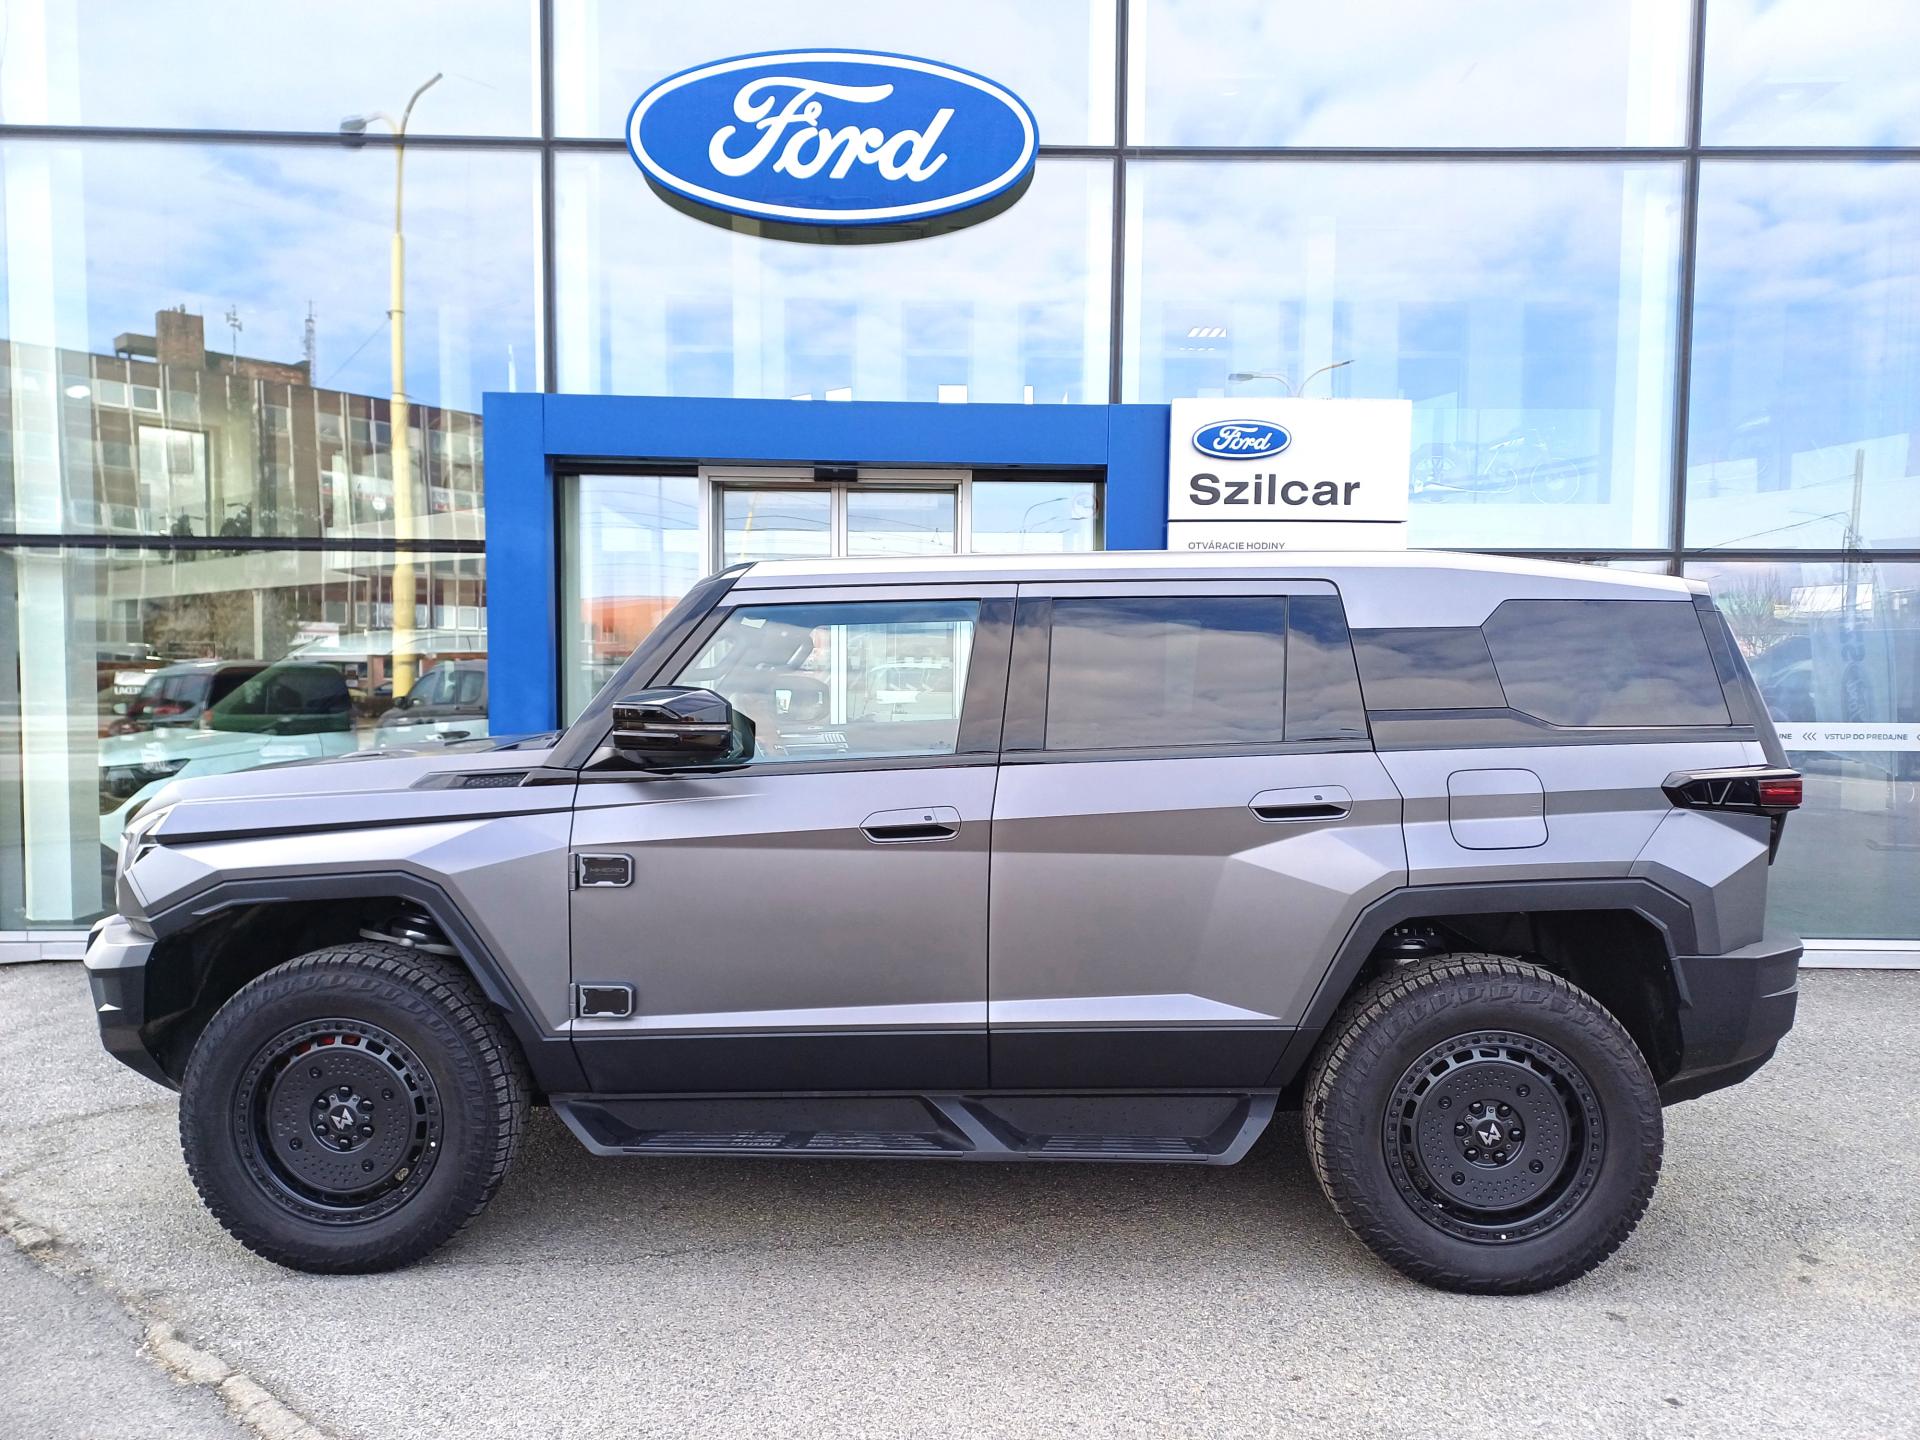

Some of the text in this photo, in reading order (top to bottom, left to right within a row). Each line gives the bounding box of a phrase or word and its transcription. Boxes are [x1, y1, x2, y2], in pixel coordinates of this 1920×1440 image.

[708, 76, 955, 182] Ford
[1213, 425, 1273, 450] Ford
[1189, 473, 1361, 506] Szilcar
[1188, 539, 1286, 550] OTVÁRACIE HODINY
[1824, 733, 1908, 741] VSTUP DO PREDAJNE
